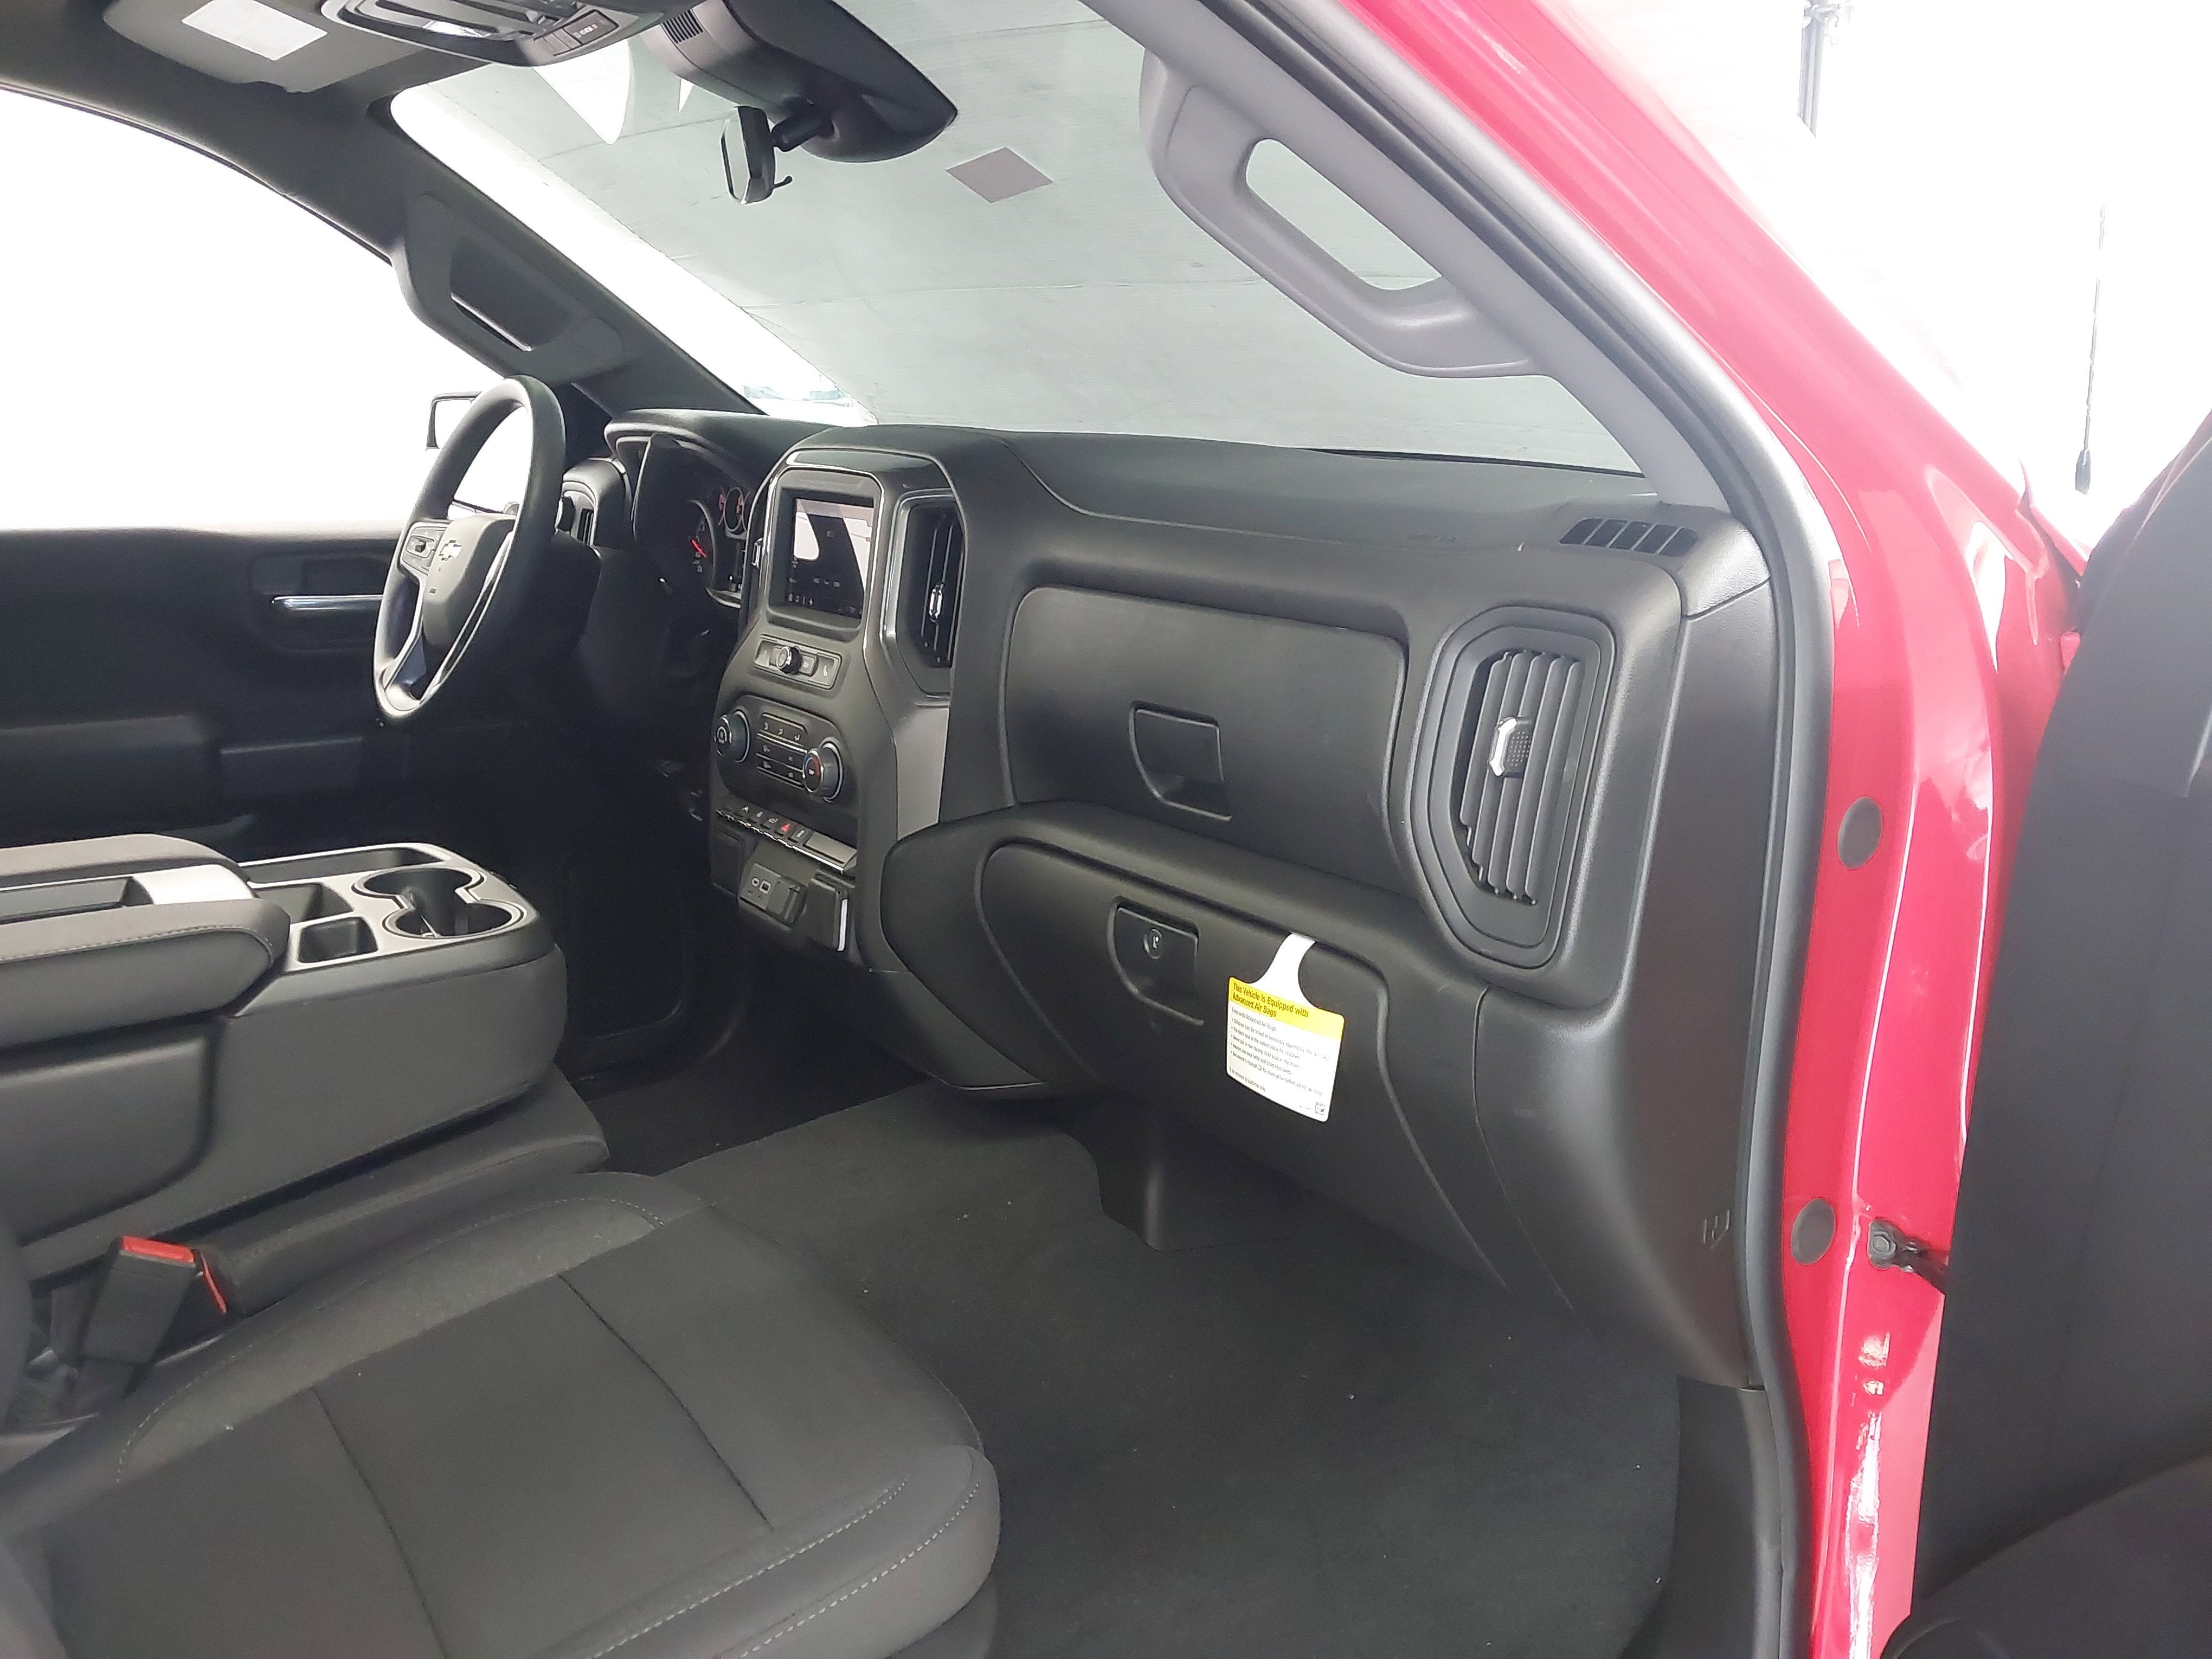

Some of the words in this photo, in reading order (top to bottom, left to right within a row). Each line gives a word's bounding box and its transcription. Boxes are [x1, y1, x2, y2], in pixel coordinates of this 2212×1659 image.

[1232, 992, 1254, 1008] Advanced
[1263, 1005, 1277, 1018] Bags
[1233, 982, 1242, 993] This
[1243, 986, 1260, 1000] Vehicle
[1267, 996, 1294, 1013] Equipped
[1295, 1007, 1309, 1017] with
